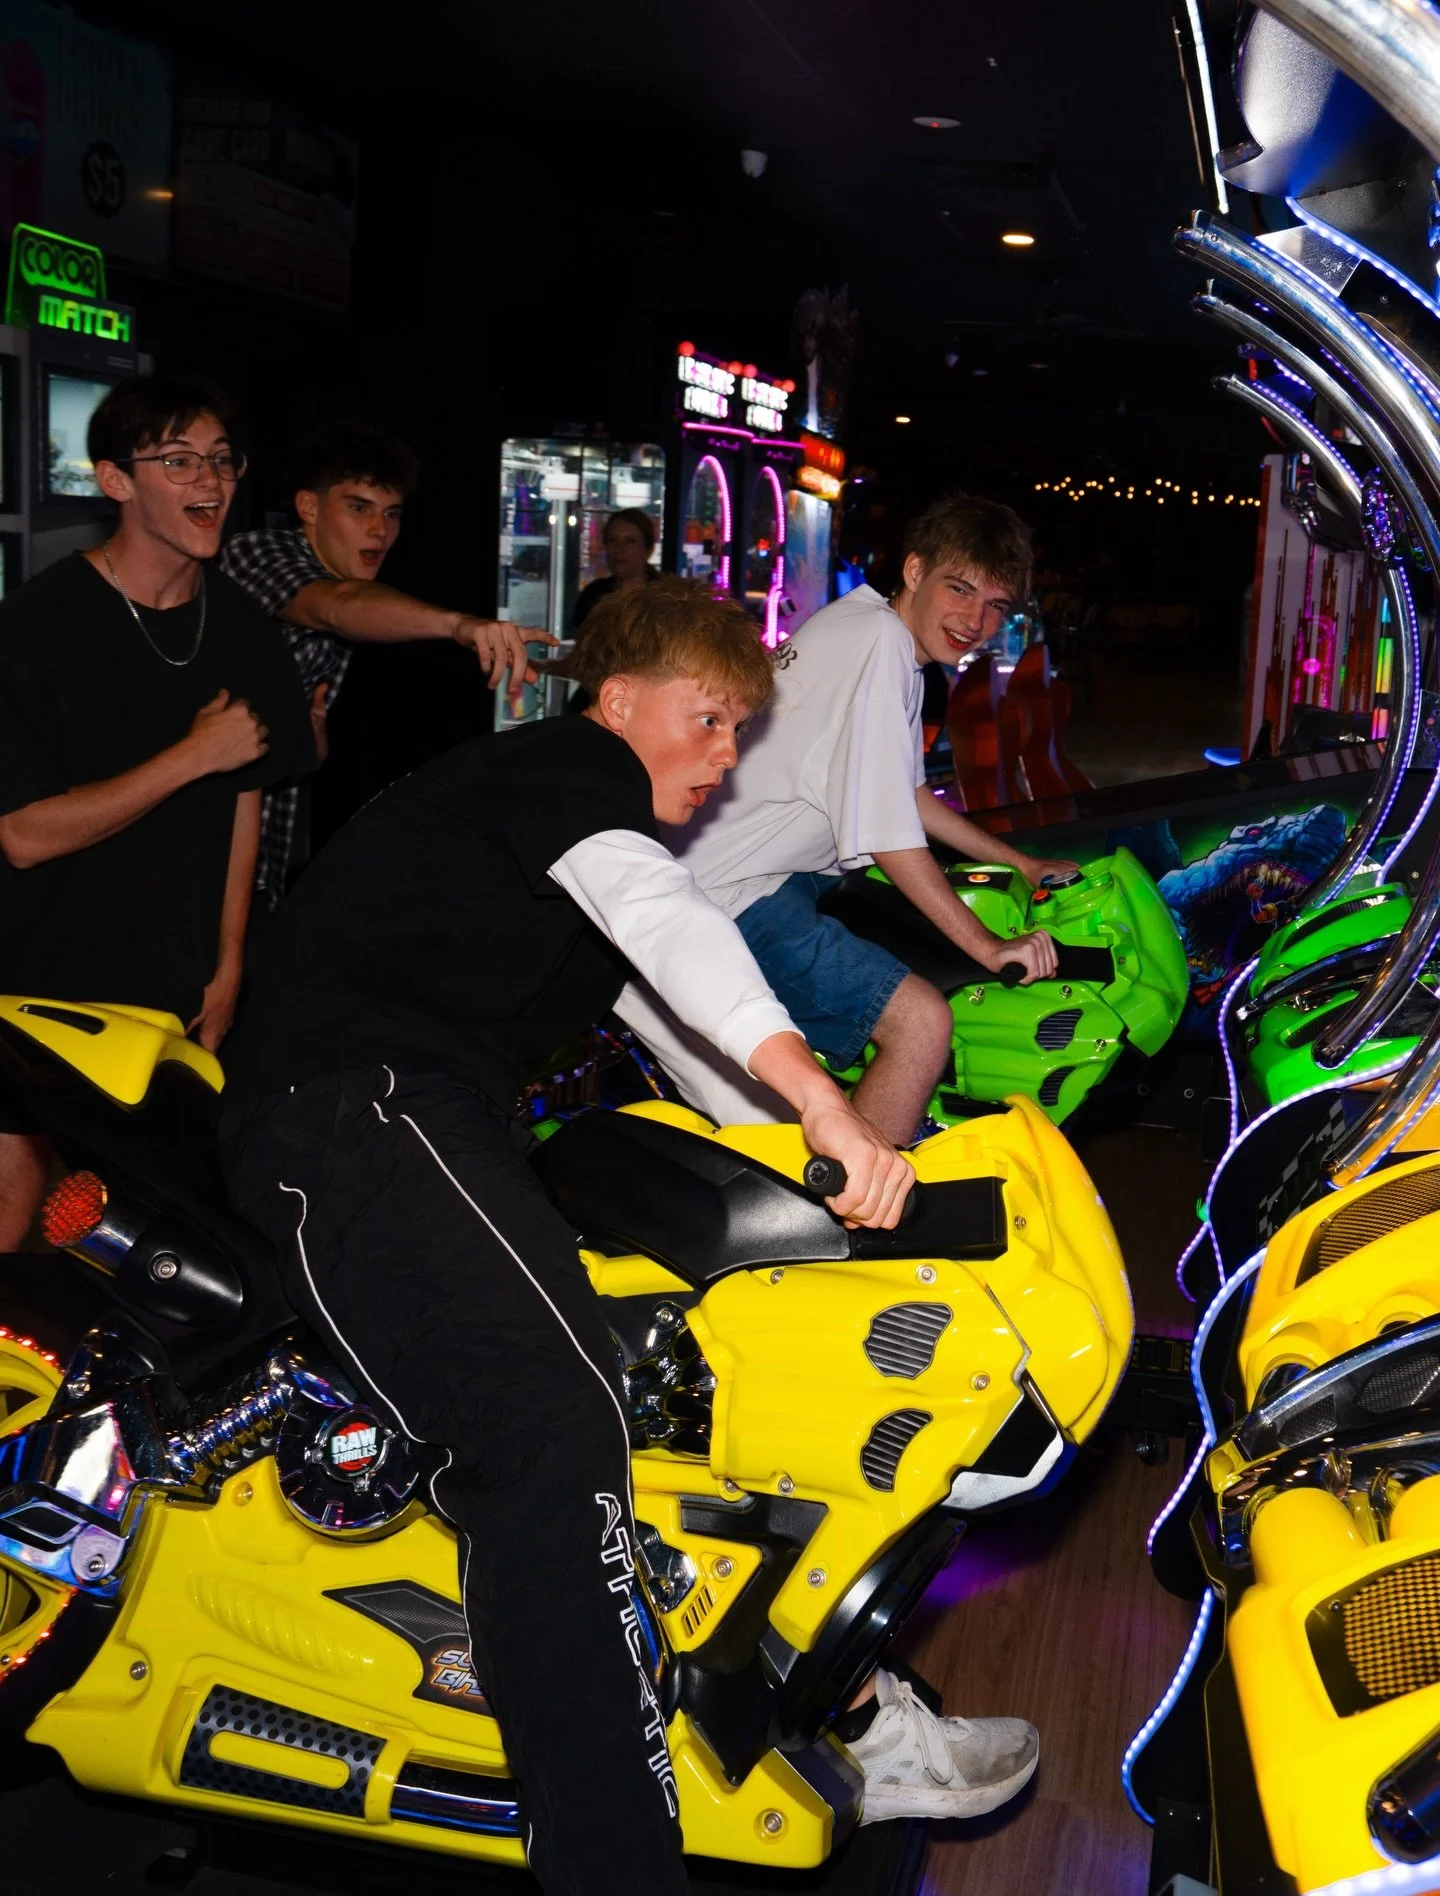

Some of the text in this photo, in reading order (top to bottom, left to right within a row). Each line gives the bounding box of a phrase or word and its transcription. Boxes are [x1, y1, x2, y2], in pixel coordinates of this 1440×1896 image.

[88, 151, 120, 207] $5
[20, 237, 97, 292] COLOR
[39, 295, 130, 343] MATCH
[331, 1427, 376, 1453] RAW
[332, 1444, 377, 1464] THRILLS
[434, 1649, 472, 1668] SU
